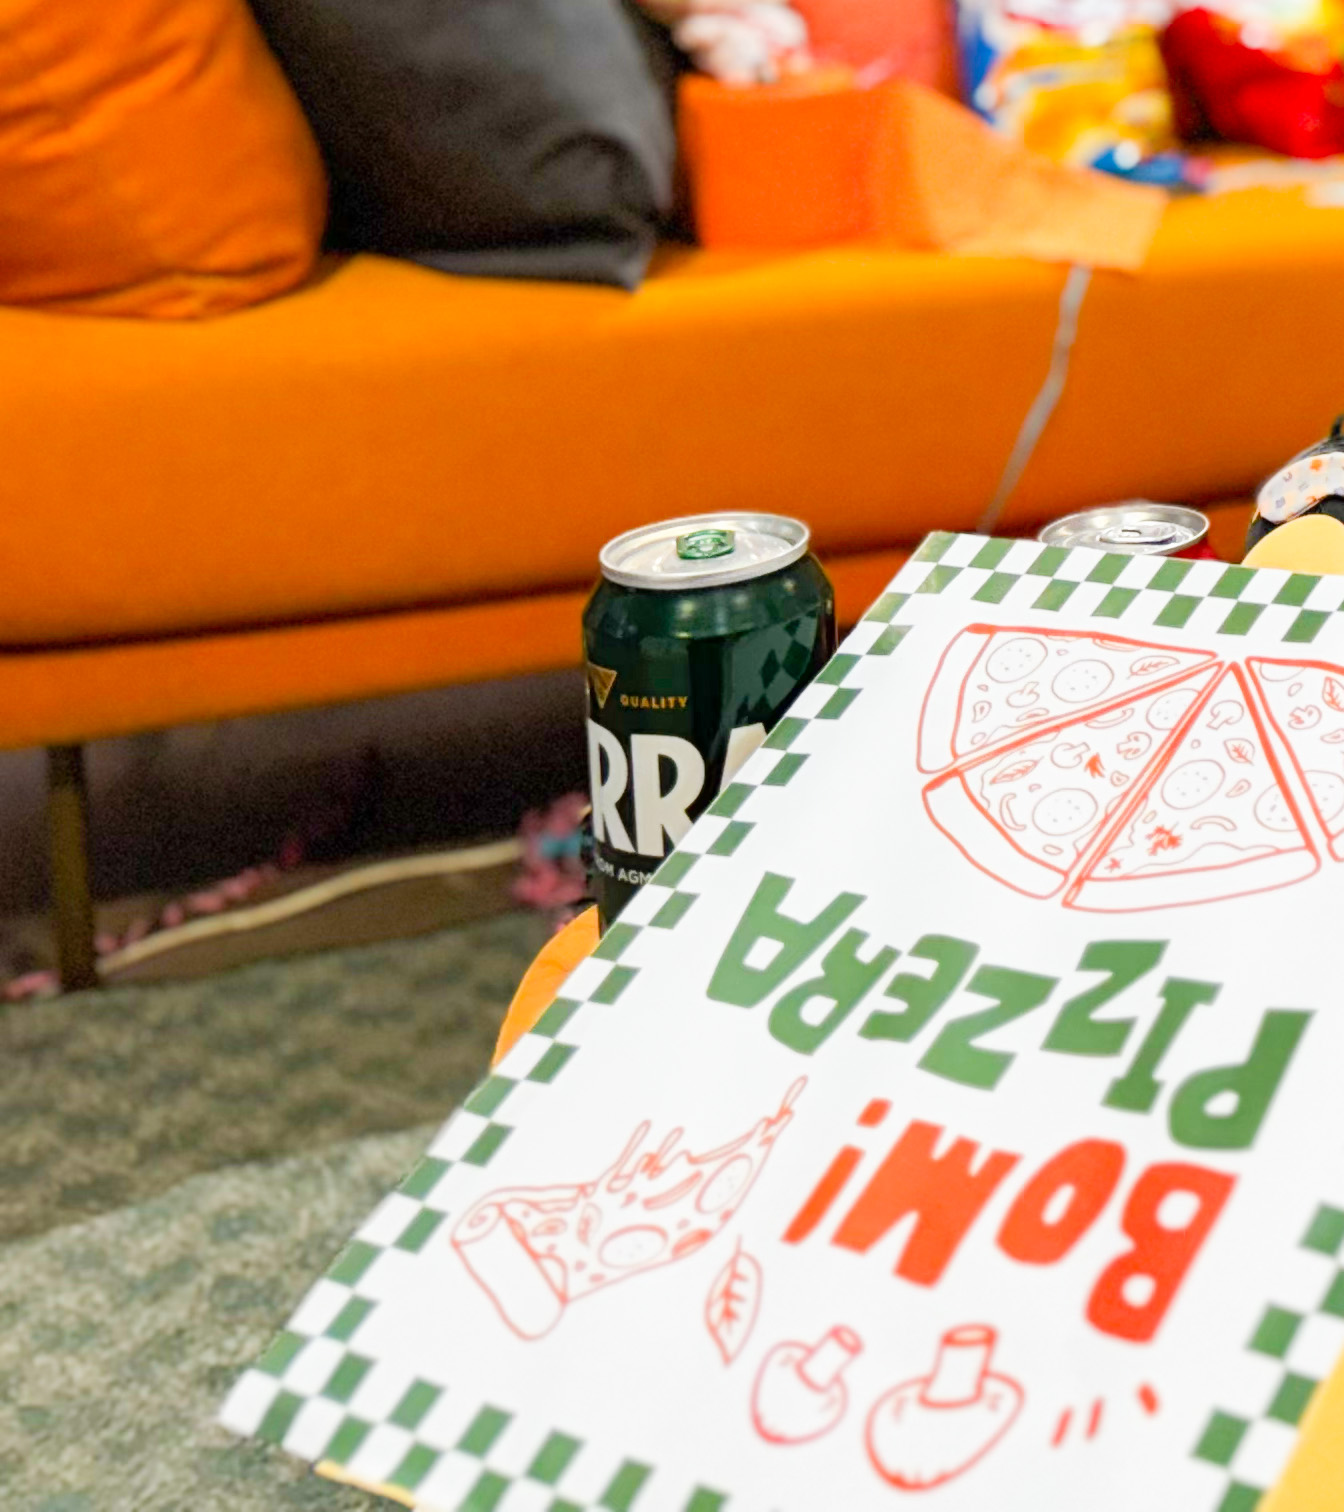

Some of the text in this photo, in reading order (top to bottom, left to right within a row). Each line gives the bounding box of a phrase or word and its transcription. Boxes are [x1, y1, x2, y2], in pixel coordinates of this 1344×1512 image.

[619, 694, 689, 711] QUALITY
[705, 871, 1317, 1152] PIZZERA
[781, 1098, 1240, 1346] BOM!
